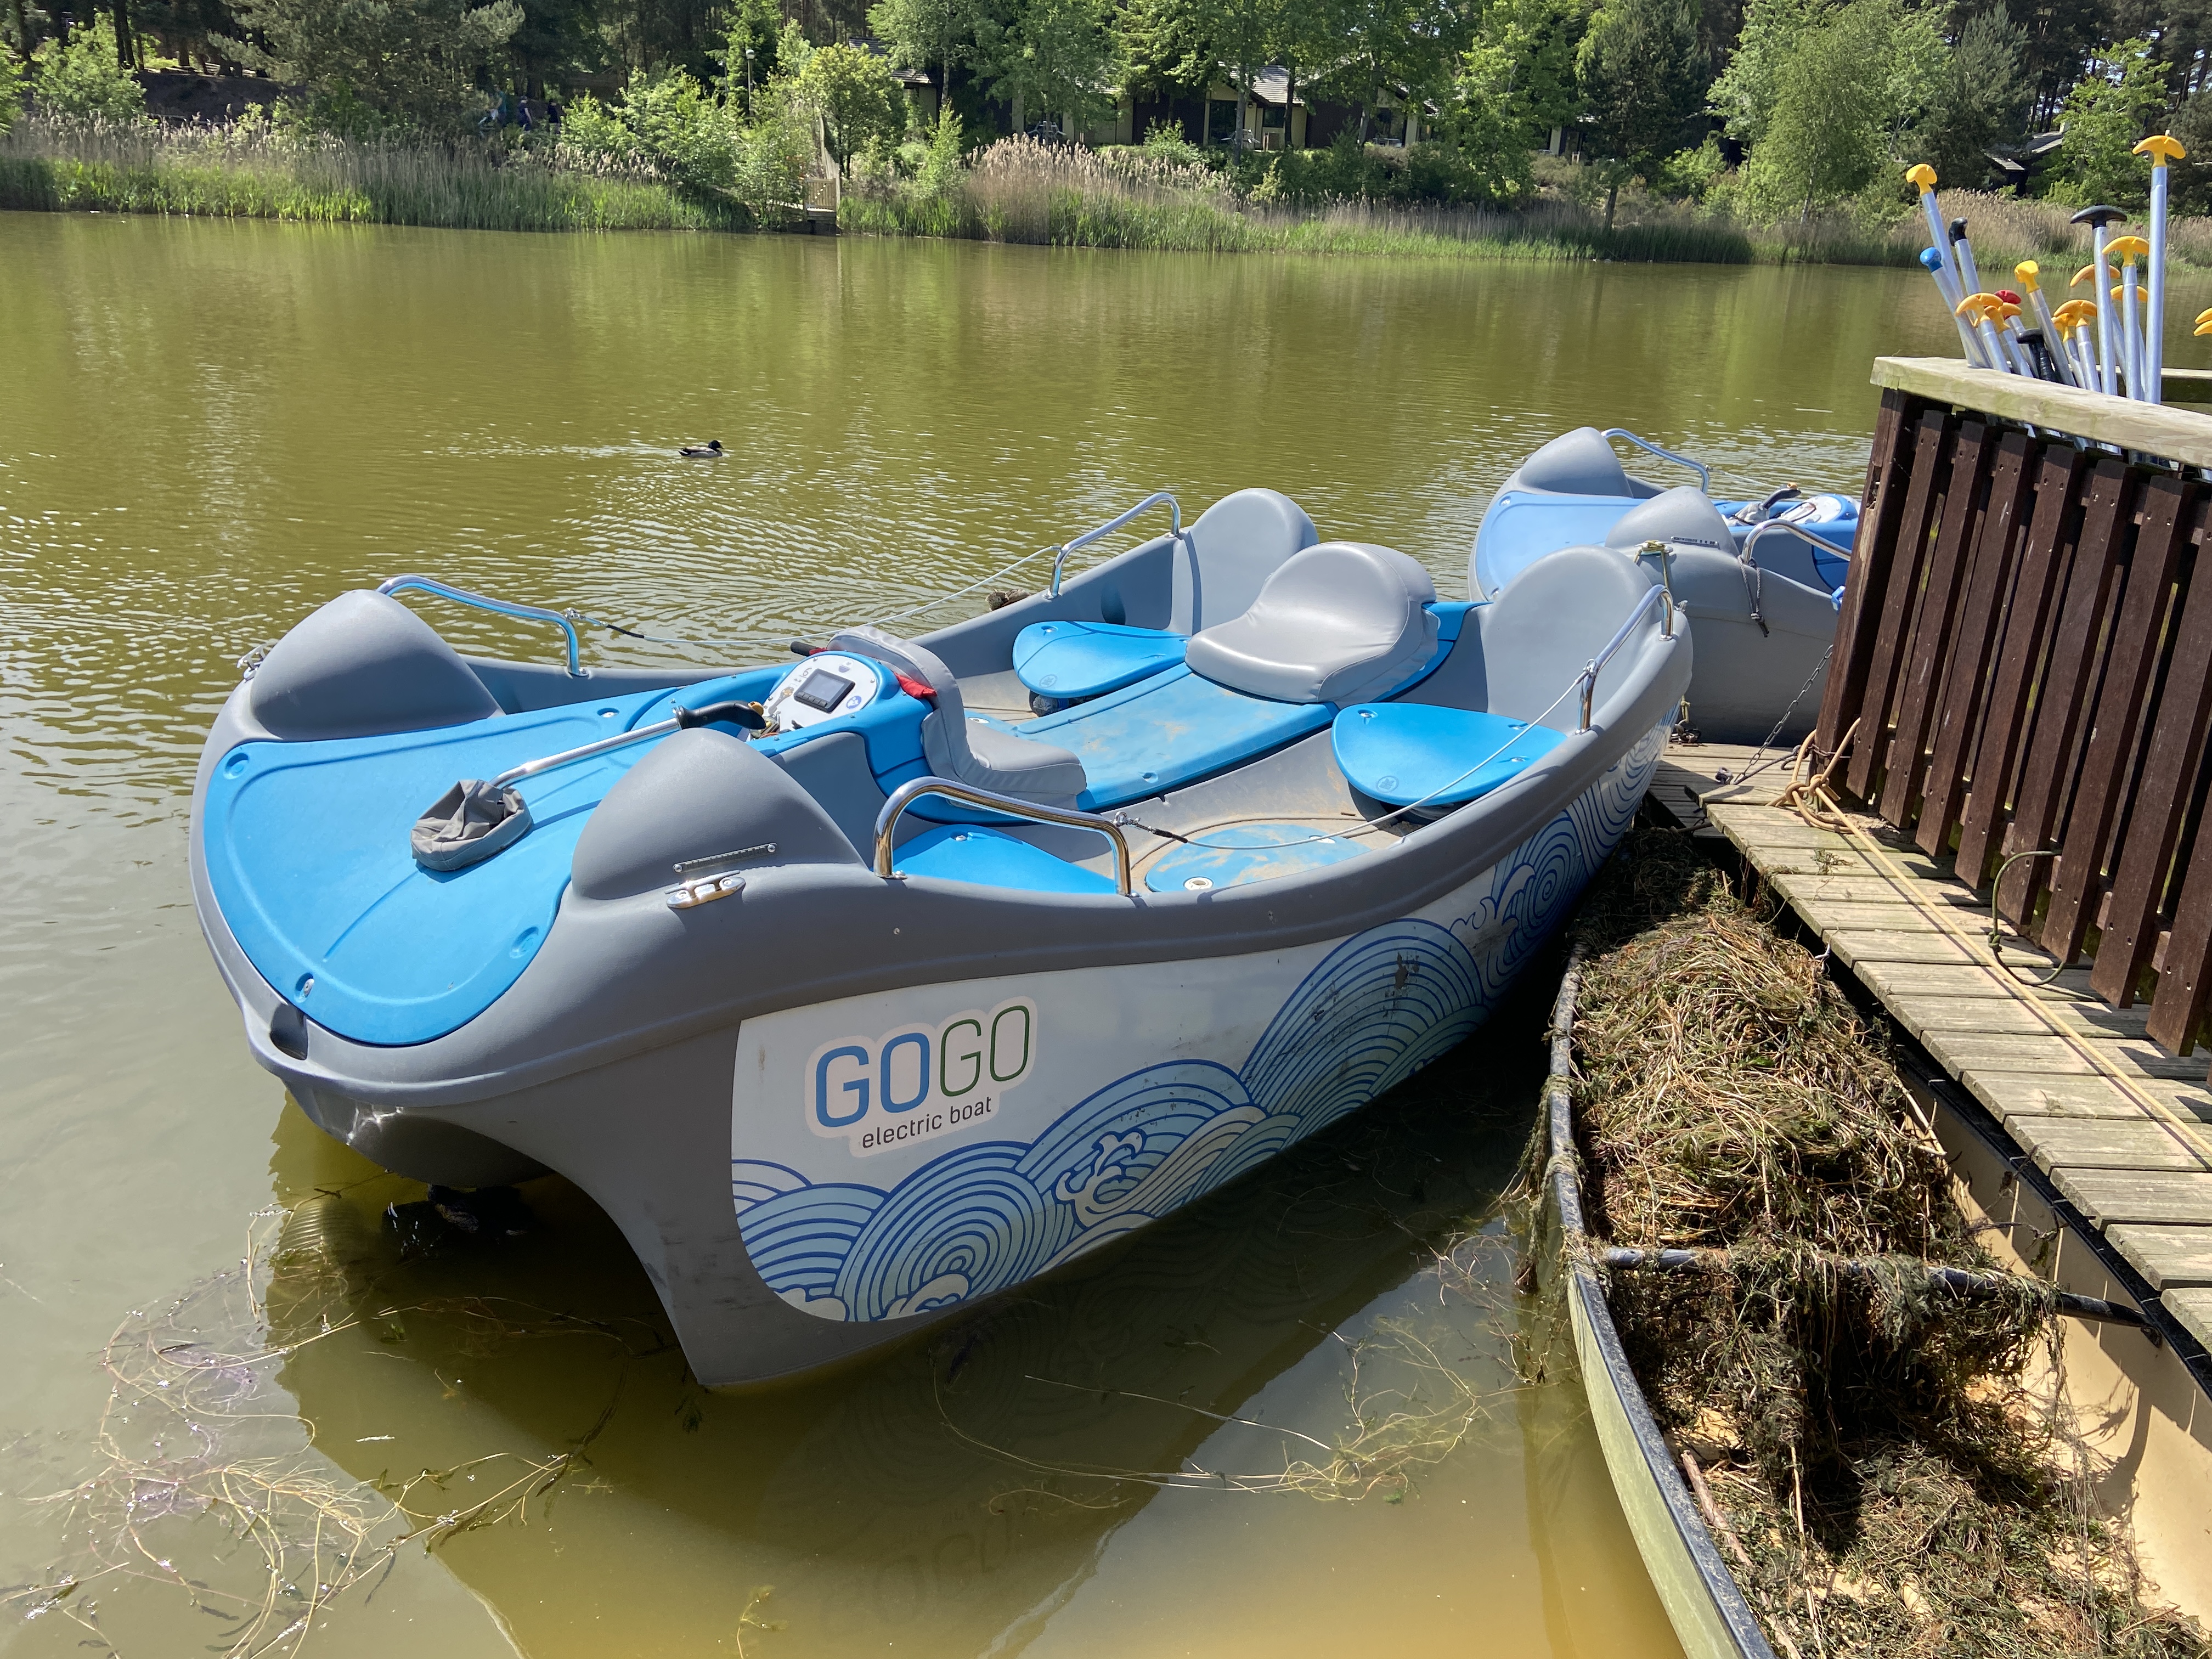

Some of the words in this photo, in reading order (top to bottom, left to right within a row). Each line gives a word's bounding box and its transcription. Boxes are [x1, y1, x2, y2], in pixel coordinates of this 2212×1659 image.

[815, 1005, 1030, 1128] GOGO
[862, 1114, 943, 1149] electric
[950, 1096, 992, 1124] boat
